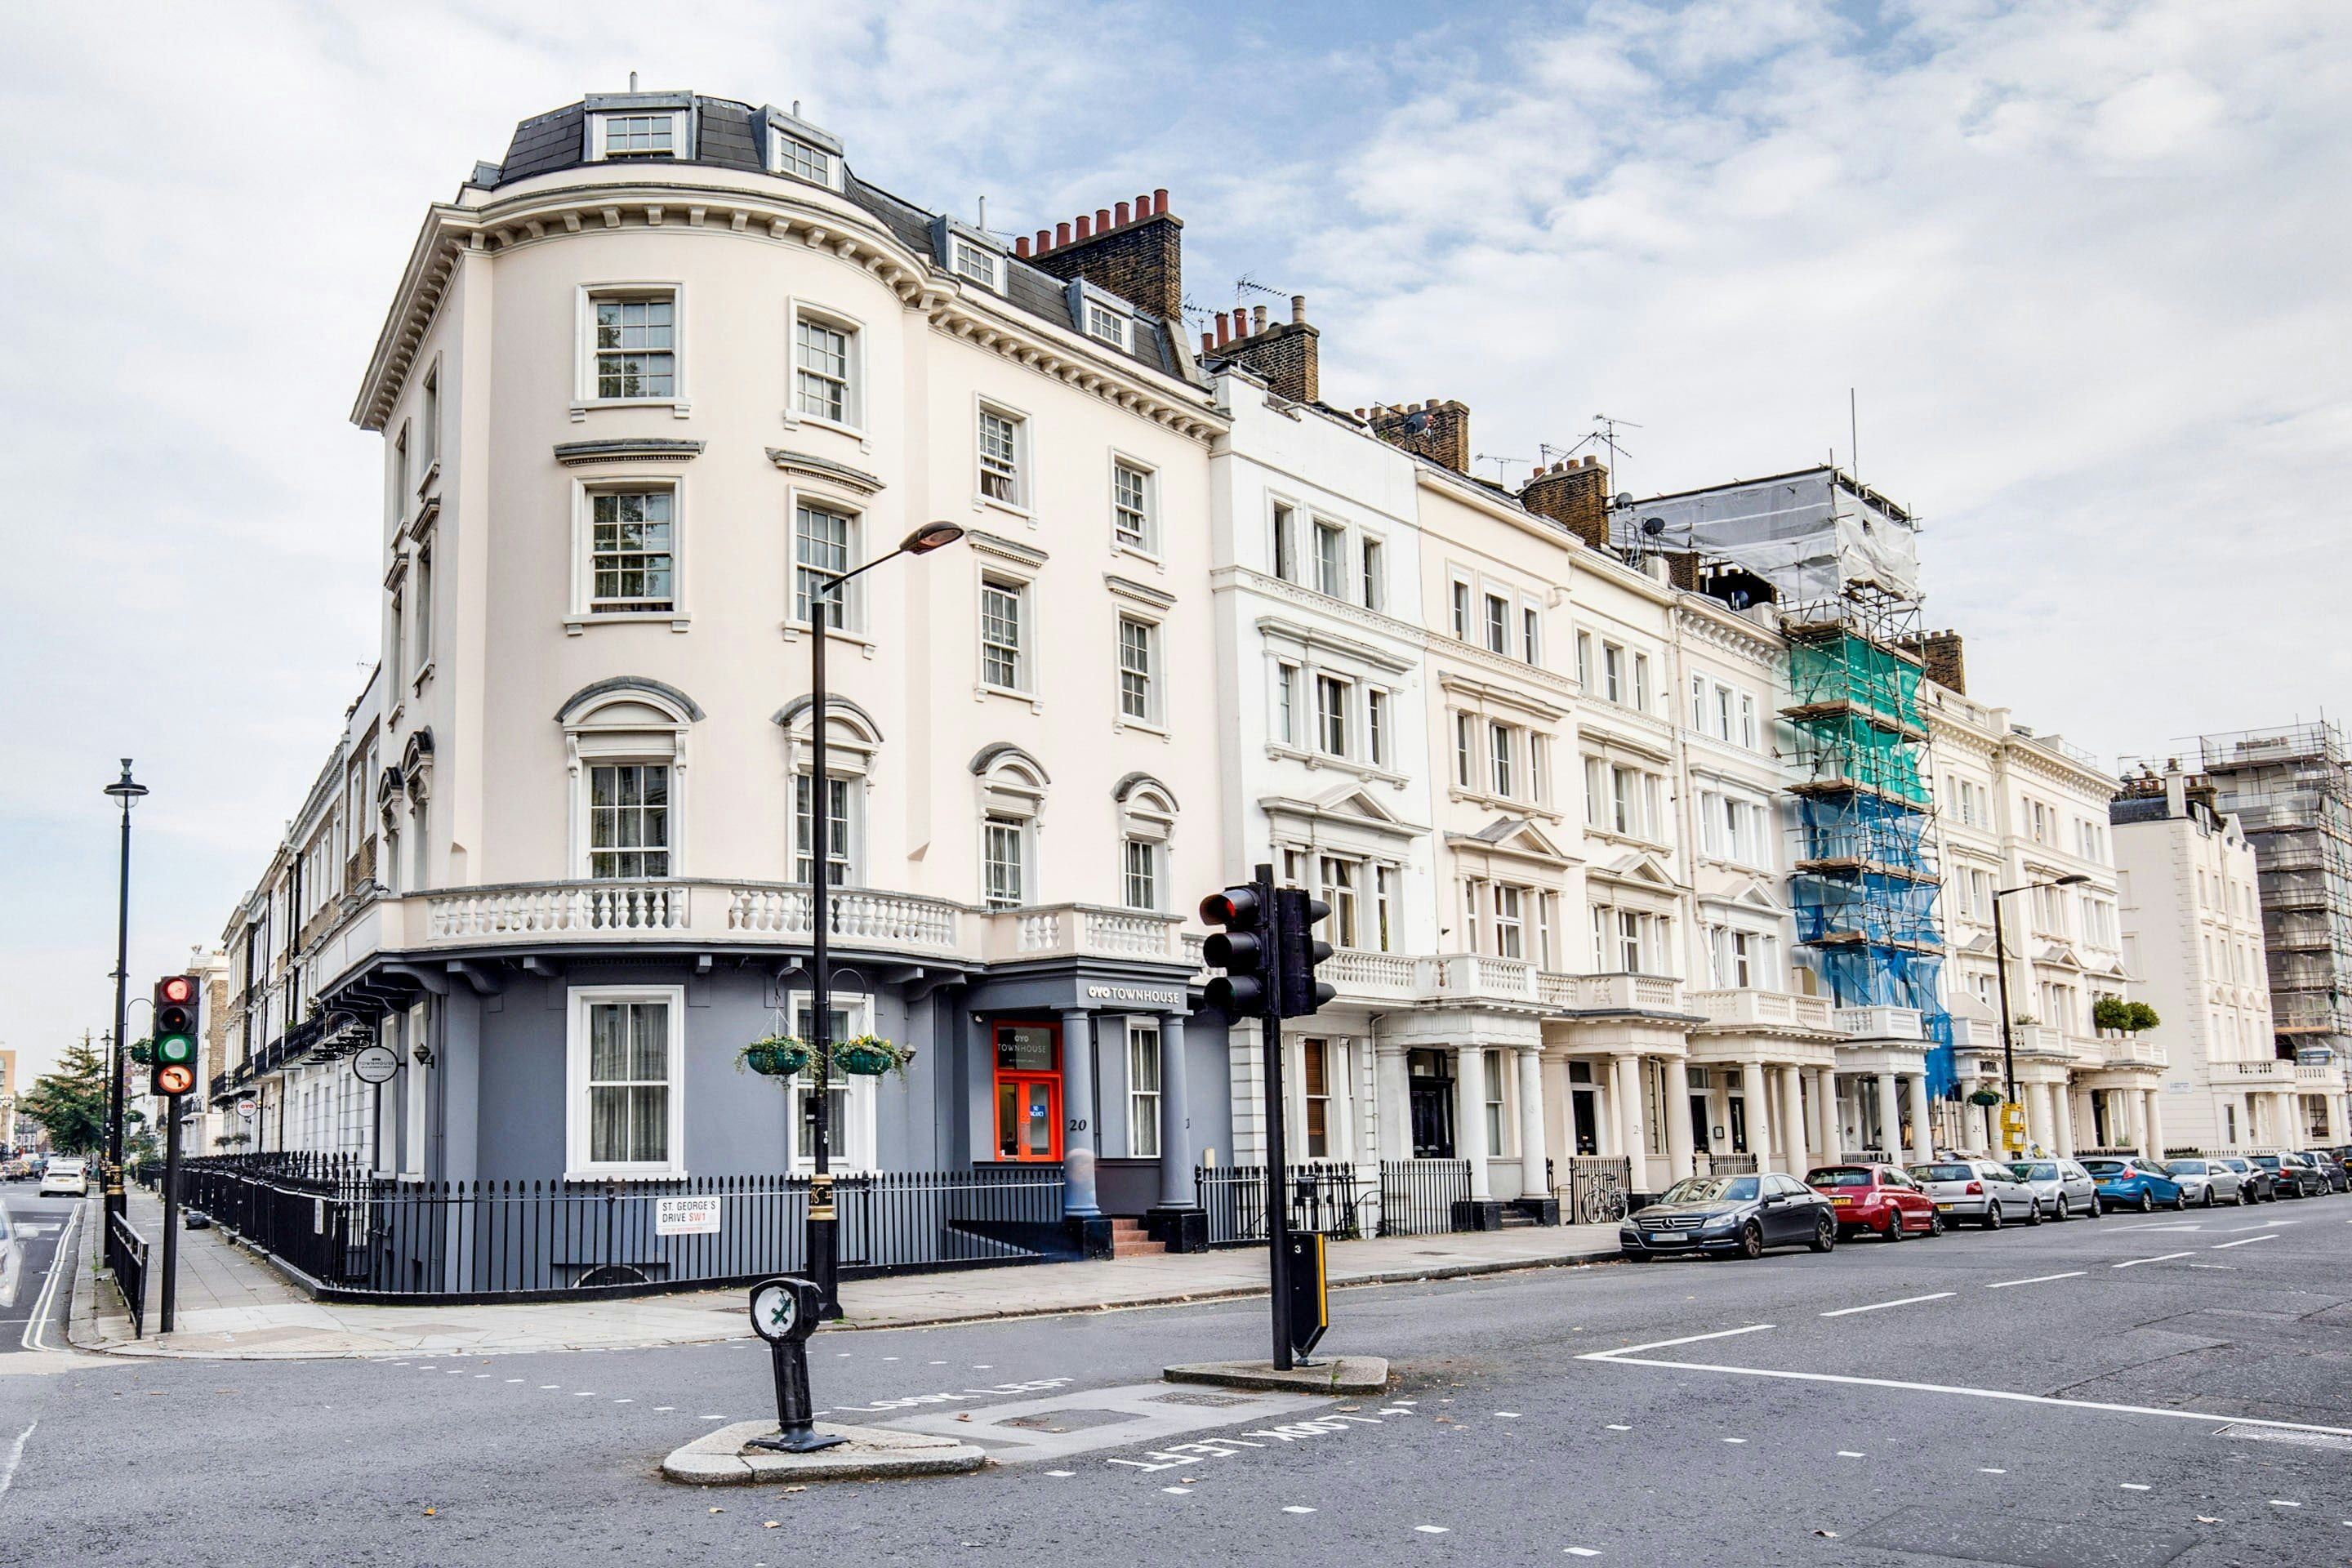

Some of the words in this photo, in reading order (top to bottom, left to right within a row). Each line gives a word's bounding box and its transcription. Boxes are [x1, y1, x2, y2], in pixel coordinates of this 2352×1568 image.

[1088, 986, 1111, 998] OYO
[1111, 987, 1180, 1004] TOWNHOUSE
[1014, 1035, 1029, 1043] OYO
[997, 1044, 1046, 1054] TOWNHOUSE
[1070, 1120, 1087, 1132] 20
[662, 1202, 674, 1212] ST.
[677, 1200, 715, 1211] GEORGE'S
[662, 1213, 686, 1223] DRIVE
[688, 1212, 706, 1222] SW1
[1294, 1245, 1302, 1254] 3
[833, 1392, 981, 1412] LOOK
[1241, 1414, 1383, 1441] LOOK
[1107, 1437, 1266, 1472] LEFT
